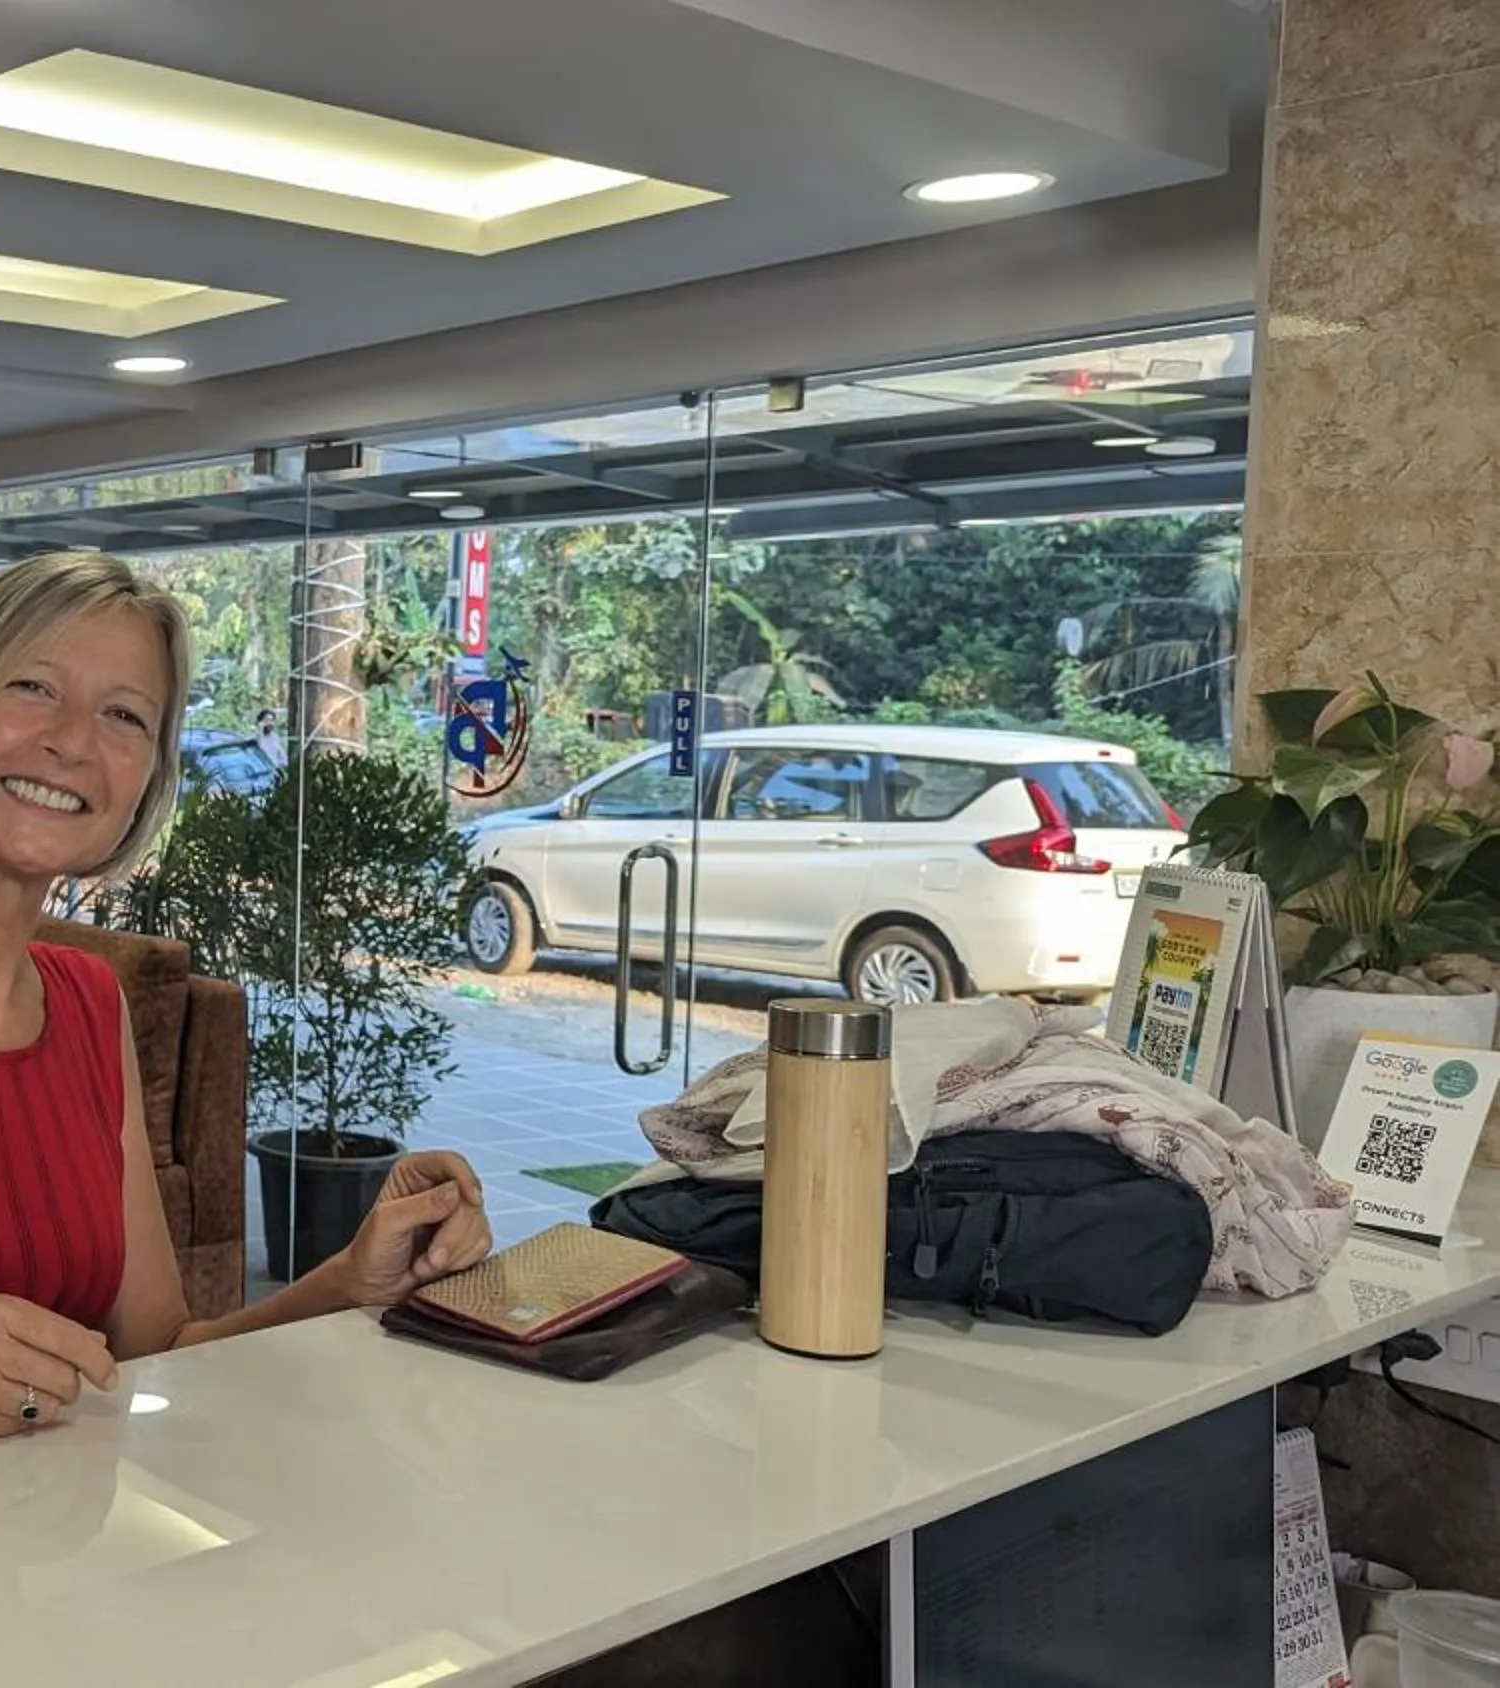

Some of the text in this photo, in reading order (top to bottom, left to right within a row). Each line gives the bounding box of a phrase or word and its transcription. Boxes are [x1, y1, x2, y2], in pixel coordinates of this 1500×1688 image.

[676, 699, 692, 771] PULL
[1366, 1050, 1428, 1077] Google
[1353, 1199, 1426, 1224] CONNECTS
[1283, 1533, 1290, 1548] 2
